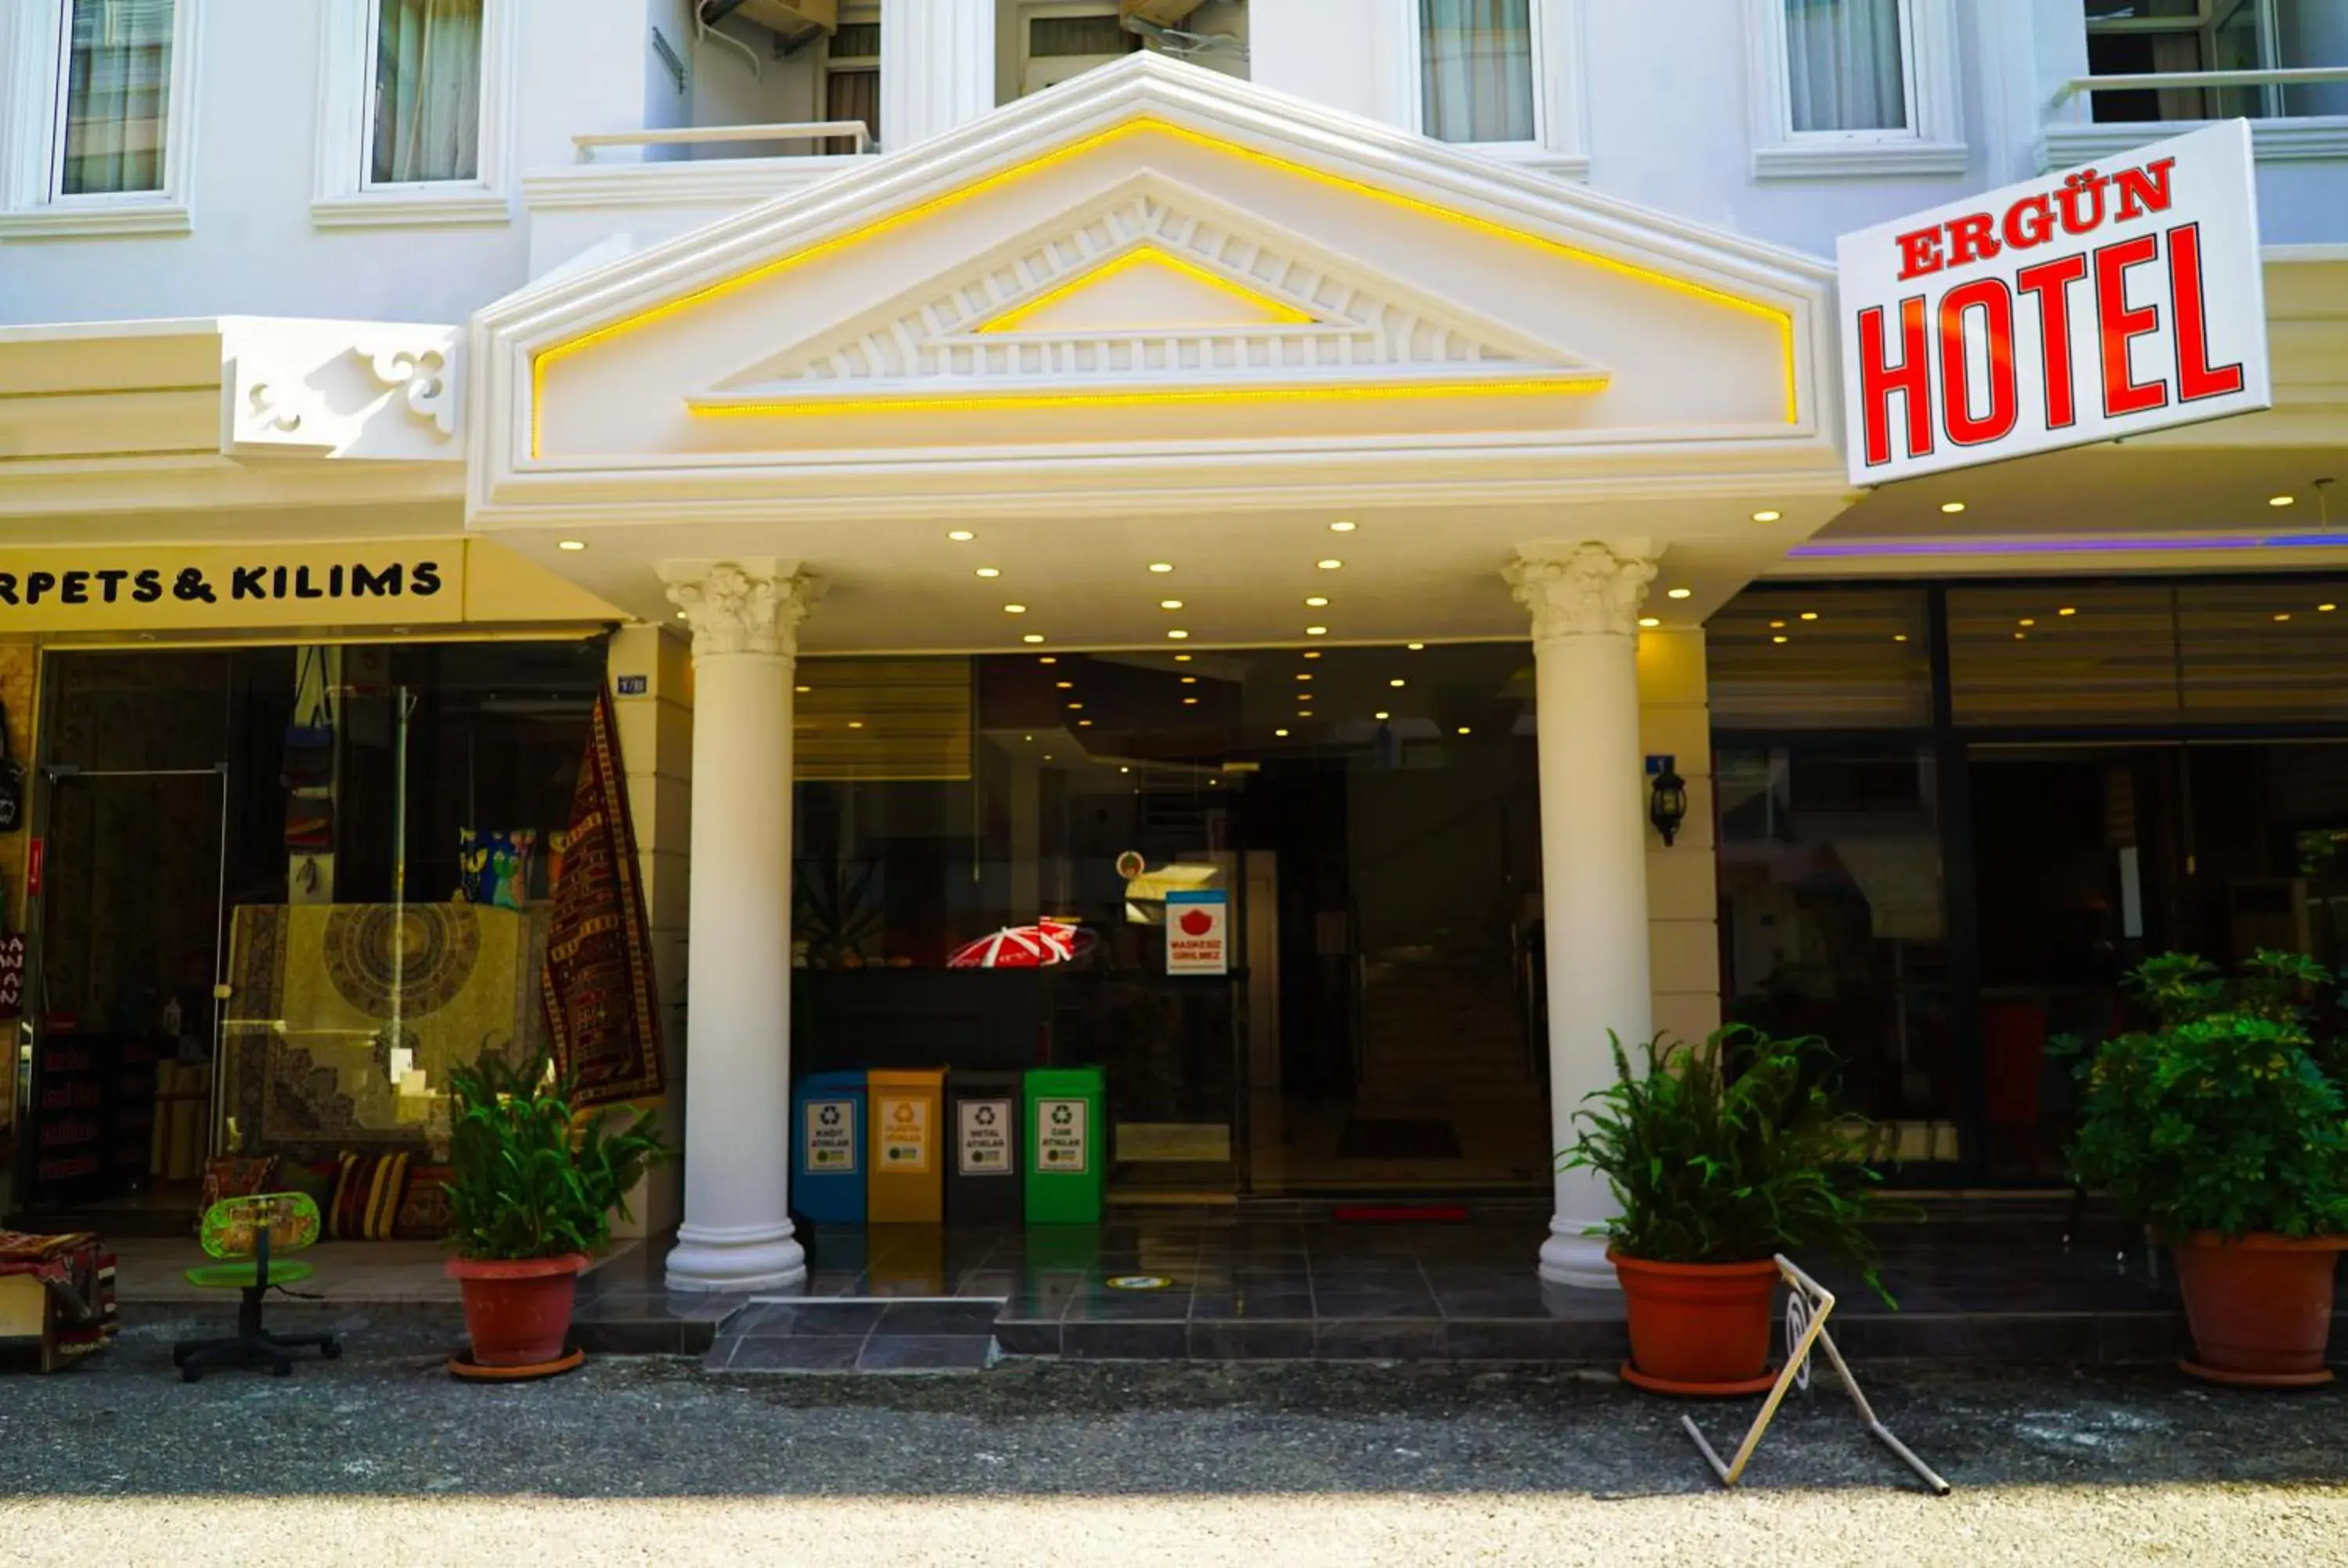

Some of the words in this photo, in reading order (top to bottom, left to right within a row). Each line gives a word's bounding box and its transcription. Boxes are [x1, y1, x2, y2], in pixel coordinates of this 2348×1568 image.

[1895, 156, 2176, 282] ERGÜN
[1857, 221, 2245, 468] HOTEL
[232, 561, 441, 601] KILIMS
